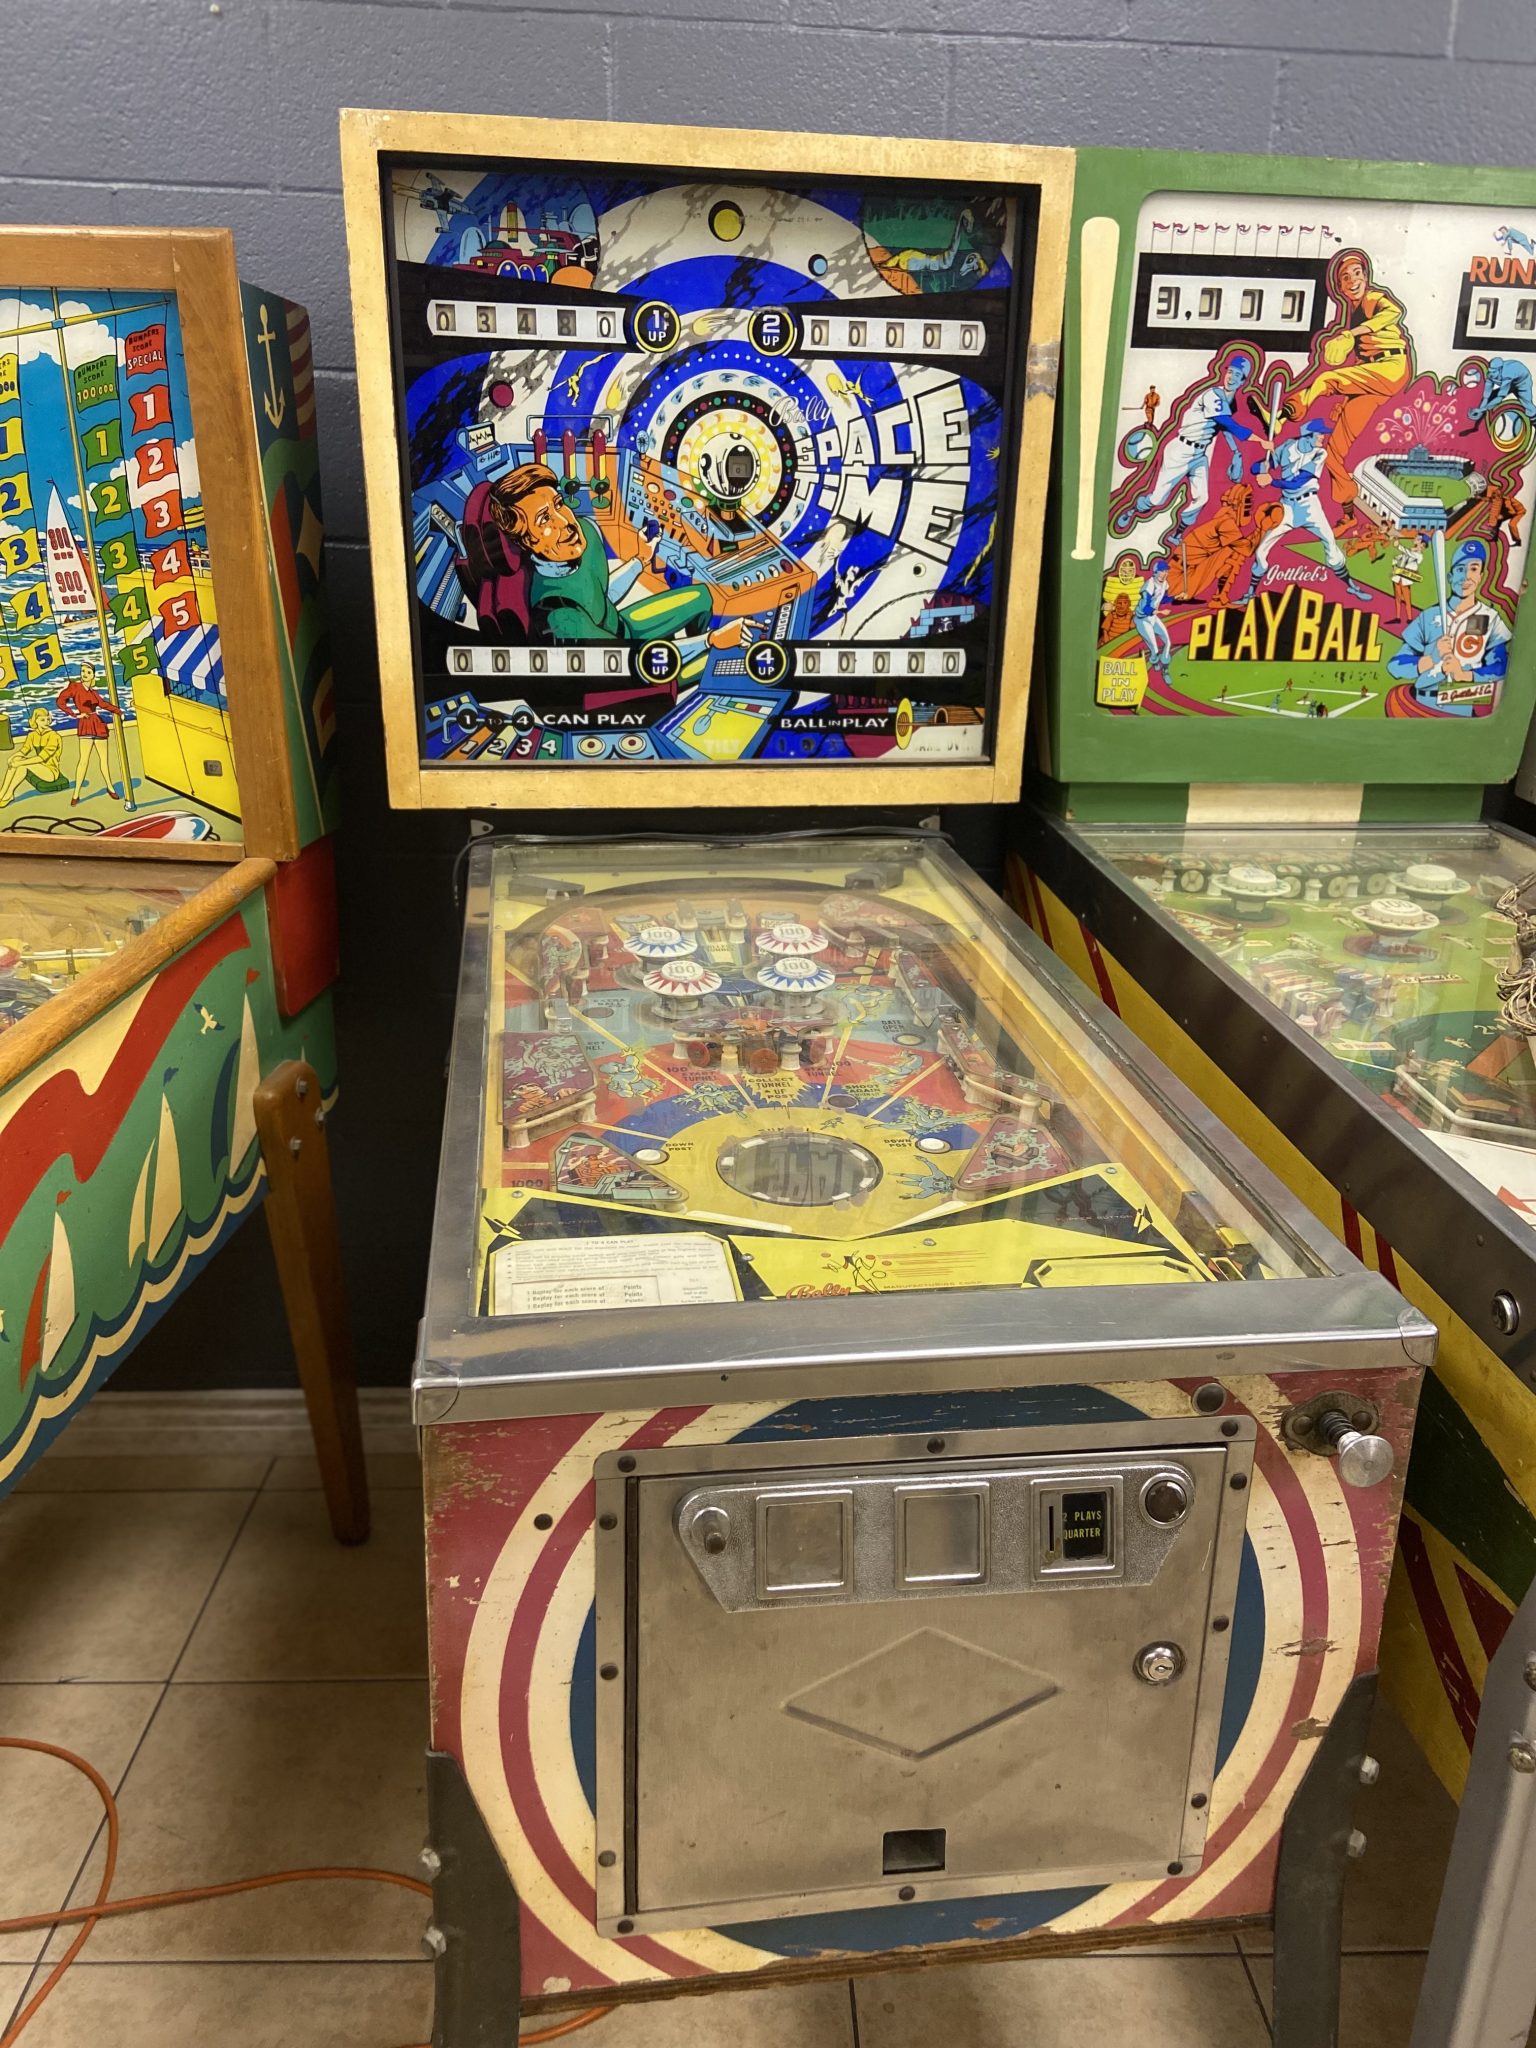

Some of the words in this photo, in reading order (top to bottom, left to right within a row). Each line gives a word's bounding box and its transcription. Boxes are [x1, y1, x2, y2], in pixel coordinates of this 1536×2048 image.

[1469, 255, 1536, 285] RUN
[762, 314, 781, 333] 2
[129, 328, 160, 345] BUMPERS
[648, 331, 667, 342] UP
[762, 335, 780, 346] UP
[132, 340, 153, 352] SCORE
[127, 350, 163, 370] SPECIAL
[77, 360, 108, 378] BUMPERS
[83, 370, 105, 384] SCORE
[143, 394, 155, 421] 1
[769, 395, 834, 428] Bally
[1214, 399, 1223, 412] 3
[795, 378, 971, 467] SPACE
[96, 430, 108, 457] 1
[147, 448, 164, 475] 2
[1, 482, 21, 513] 2
[101, 486, 121, 515] 2
[153, 501, 171, 529] 3
[9, 538, 29, 566] 3
[109, 542, 128, 570] 3
[161, 549, 181, 574] 4
[1264, 565, 1328, 586] Gottlieb's
[25, 590, 43, 620] 4
[122, 596, 141, 621] 4
[171, 600, 190, 626] 5
[1188, 584, 1297, 662] PLAY
[1293, 587, 1383, 662] BALL
[34, 643, 54, 670] 5
[133, 645, 149, 670] 5
[651, 648, 668, 664] 3
[756, 648, 775, 665] 4
[652, 665, 668, 675] UP
[758, 667, 775, 676] UP
[1103, 661, 1138, 675] BALL
[1112, 678, 1130, 687] IN
[1102, 689, 1137, 702] PLAY
[464, 715, 471, 725] 1
[488, 717, 503, 726] TO
[516, 715, 529, 725] 4
[543, 714, 589, 725] CAN
[597, 714, 647, 725] PLAY
[780, 717, 827, 728] BALL
[828, 719, 841, 727] IN
[843, 717, 889, 728] PLAY
[460, 740, 478, 752] 1
[489, 739, 505, 755] 2
[516, 739, 532, 755] 3
[541, 740, 557, 756] 4
[652, 930, 674, 940] 100
[779, 927, 805, 937] 100
[667, 965, 696, 975] 100
[780, 962, 809, 972] 100
[533, 1295, 552, 1303] Replay
[785, 1282, 851, 1299] Bally
[533, 1302, 553, 1310] Replay
[1074, 1510, 1102, 1522] PLAYS
[1064, 1527, 1101, 1540] QUARTER
